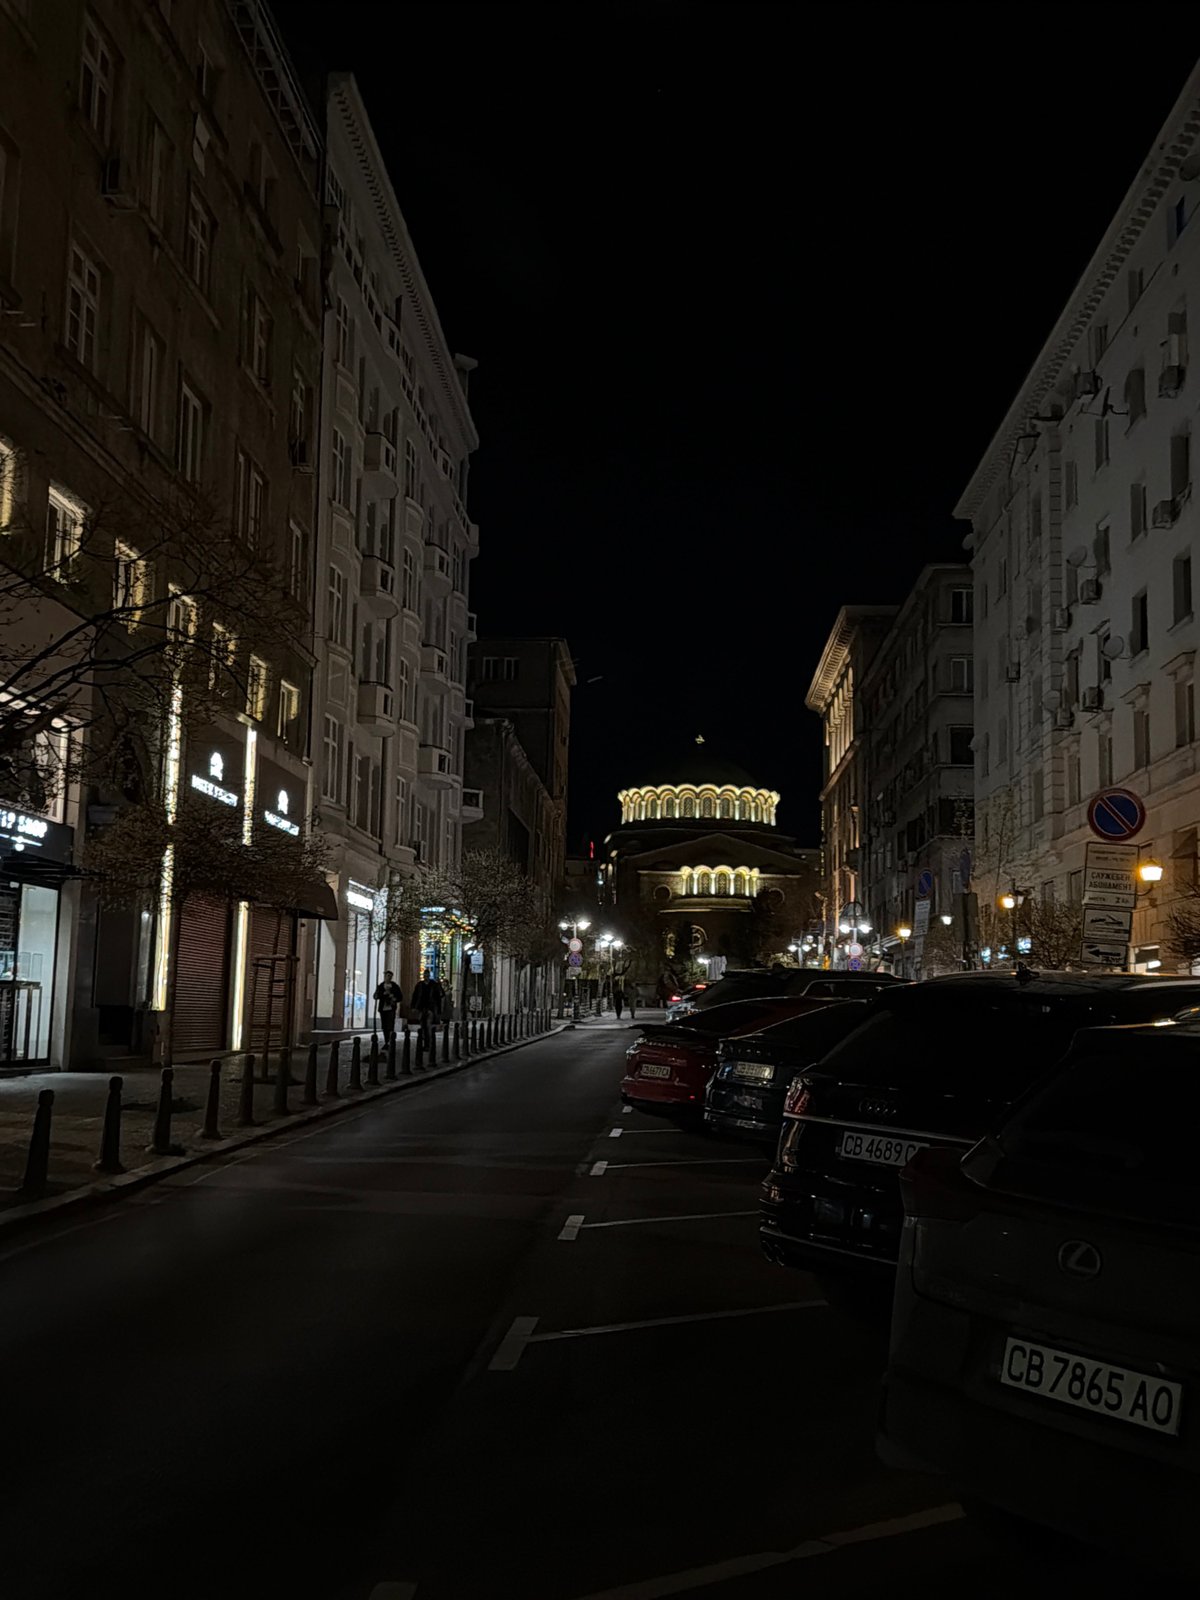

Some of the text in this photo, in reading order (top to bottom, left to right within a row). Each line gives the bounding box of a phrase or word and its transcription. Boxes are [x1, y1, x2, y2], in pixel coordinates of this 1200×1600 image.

[844, 1136, 917, 1162] CB 4689 C
[1007, 1345, 1044, 1388] CB
[1049, 1355, 1124, 1411] 7865
